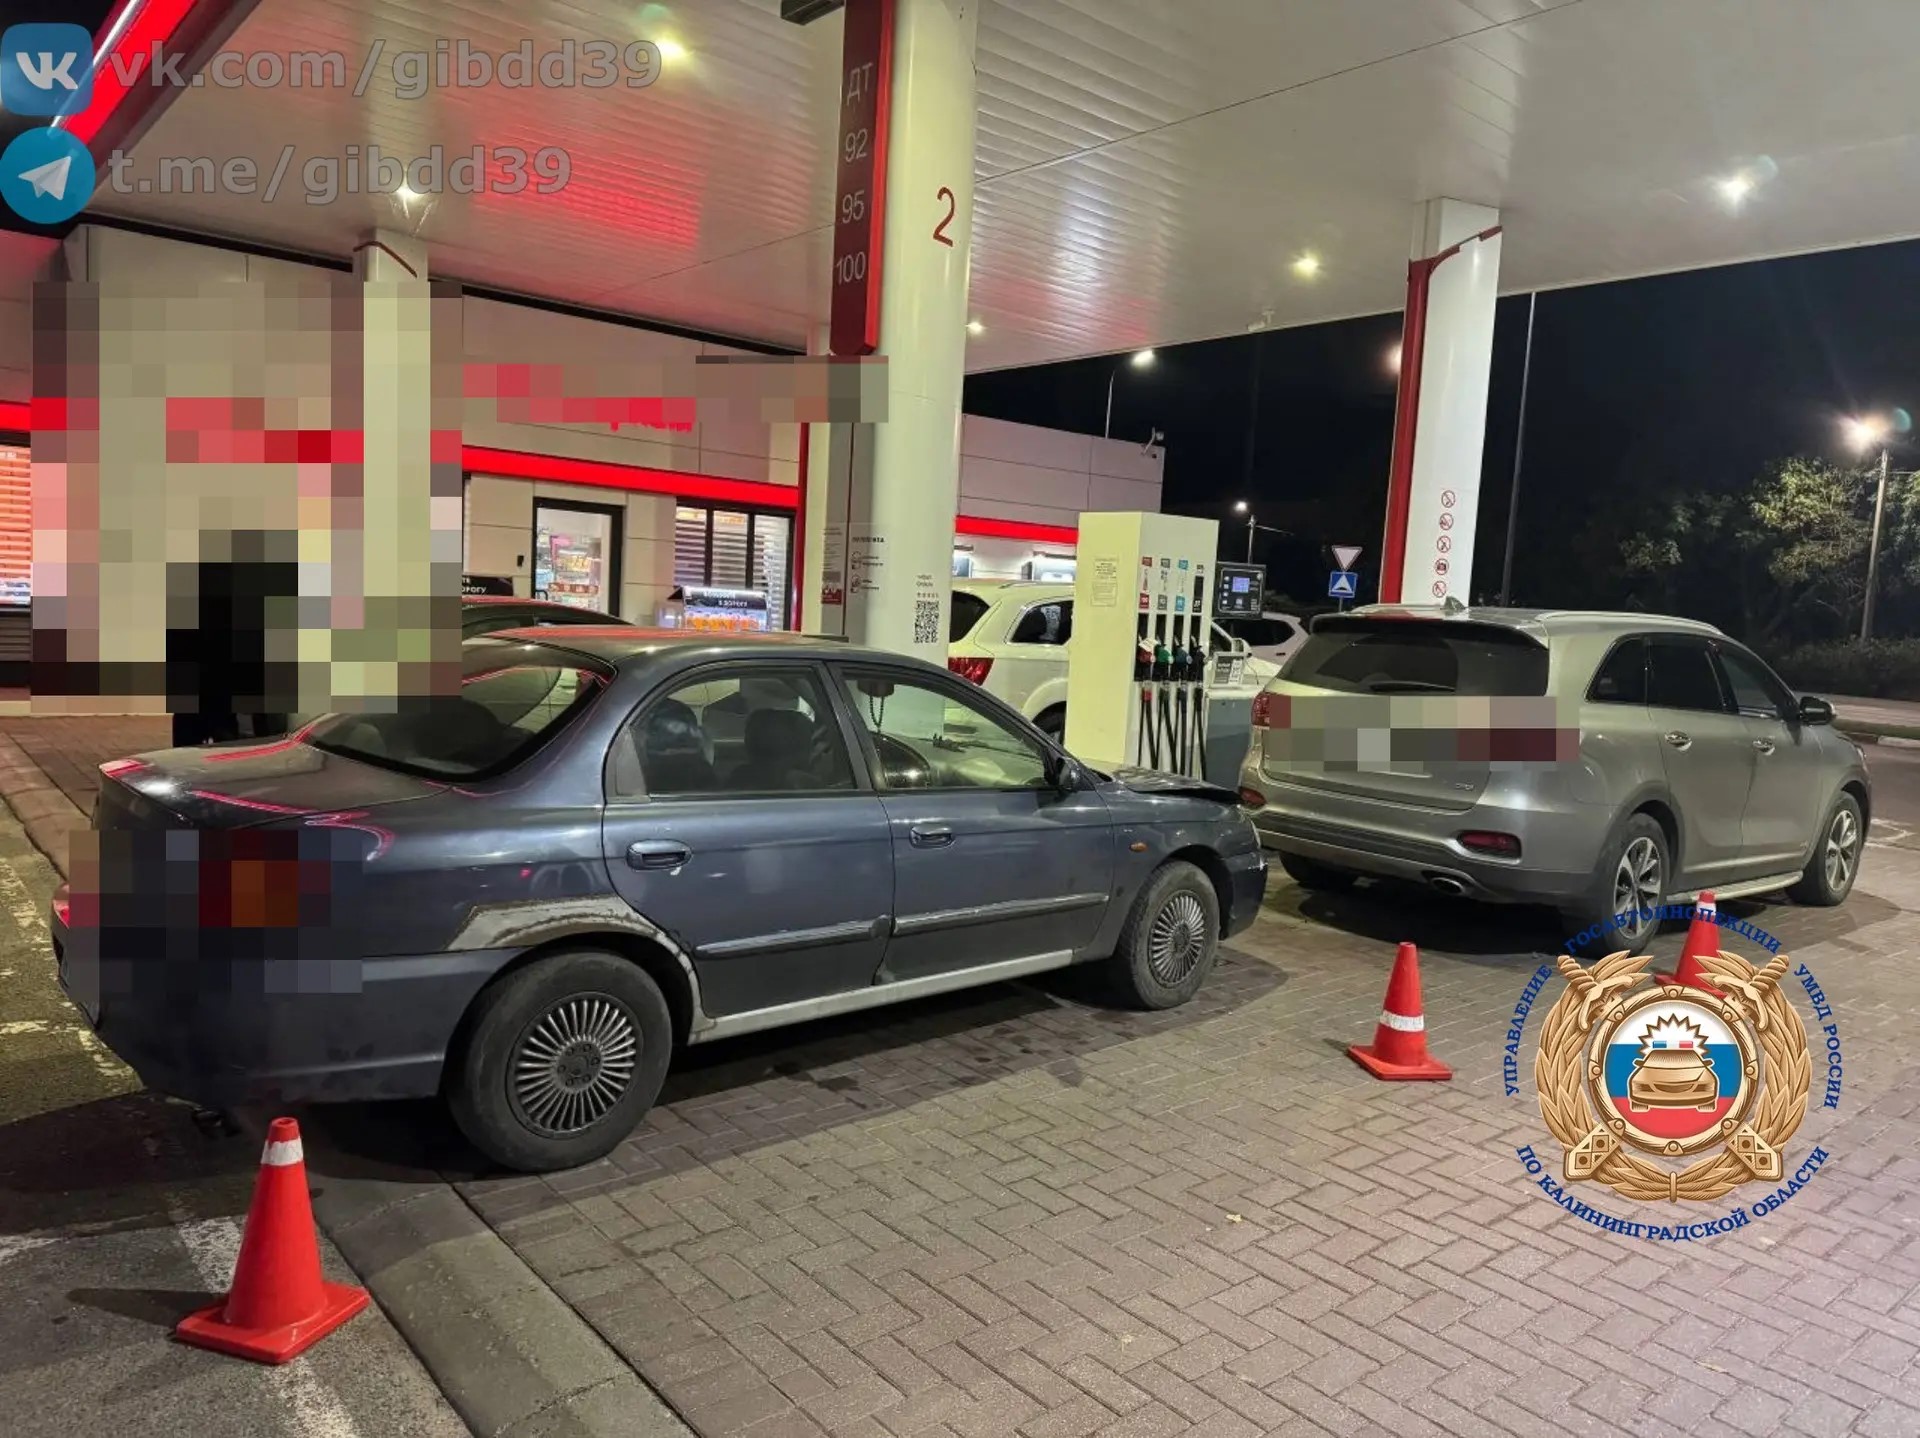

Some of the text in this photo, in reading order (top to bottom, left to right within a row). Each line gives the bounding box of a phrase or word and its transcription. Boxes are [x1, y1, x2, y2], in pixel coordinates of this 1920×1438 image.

[847, 62, 874, 105] ДТ
[844, 127, 869, 162] 92
[841, 190, 866, 224] 95
[932, 186, 956, 248] 2
[834, 251, 866, 285] 100
